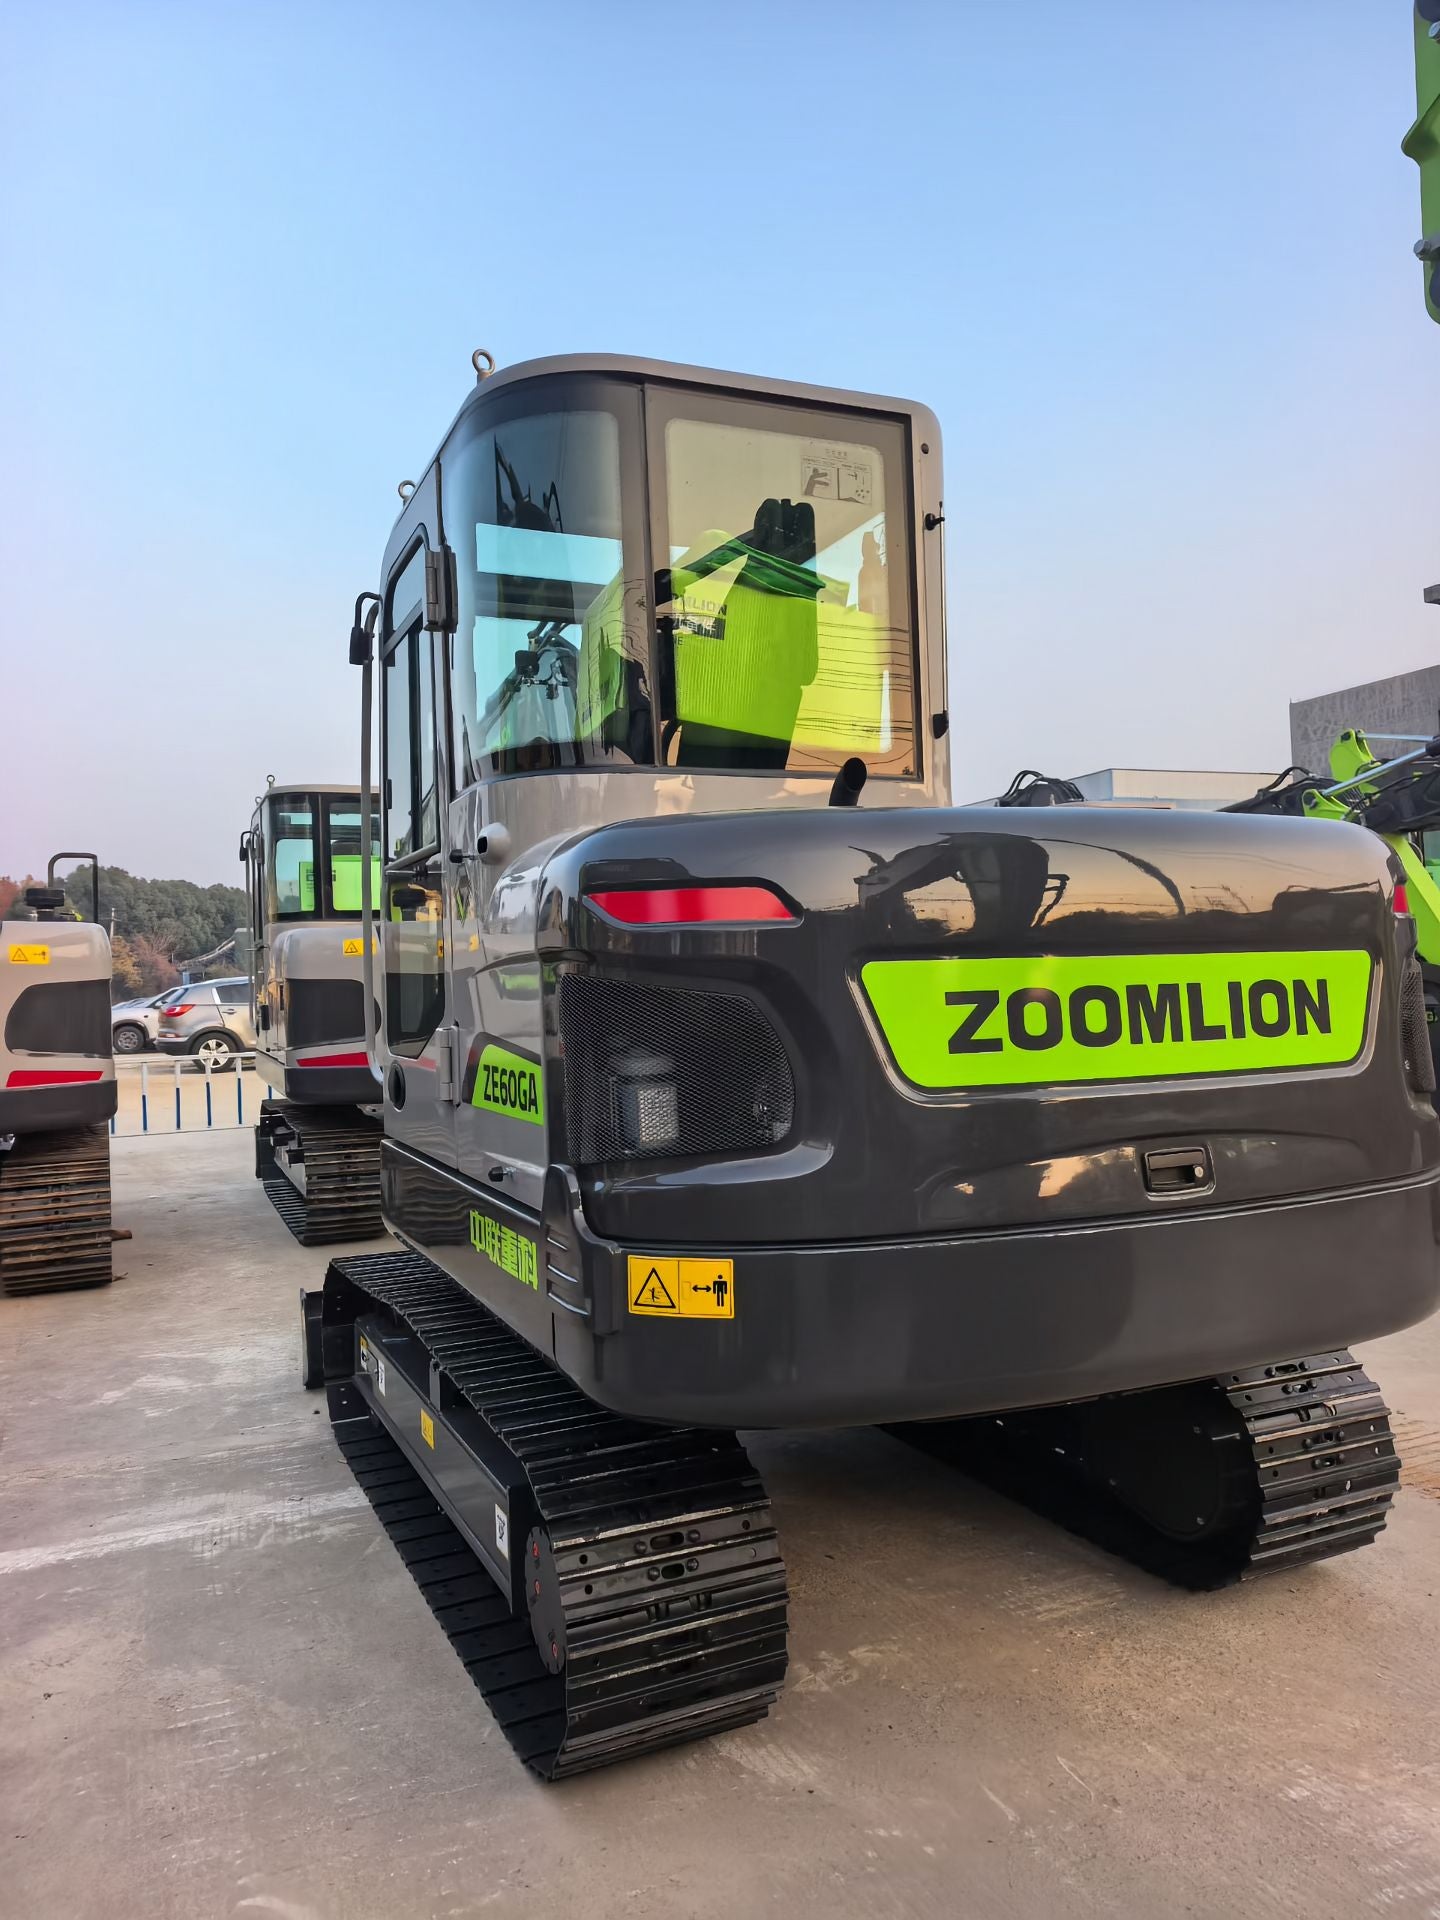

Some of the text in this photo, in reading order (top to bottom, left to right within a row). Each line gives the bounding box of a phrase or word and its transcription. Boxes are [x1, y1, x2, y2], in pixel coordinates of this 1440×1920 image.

[944, 978, 1332, 1055] ZOOMLION
[482, 1064, 539, 1115] ZE60GA
[469, 1210, 539, 1291] 中联重科
